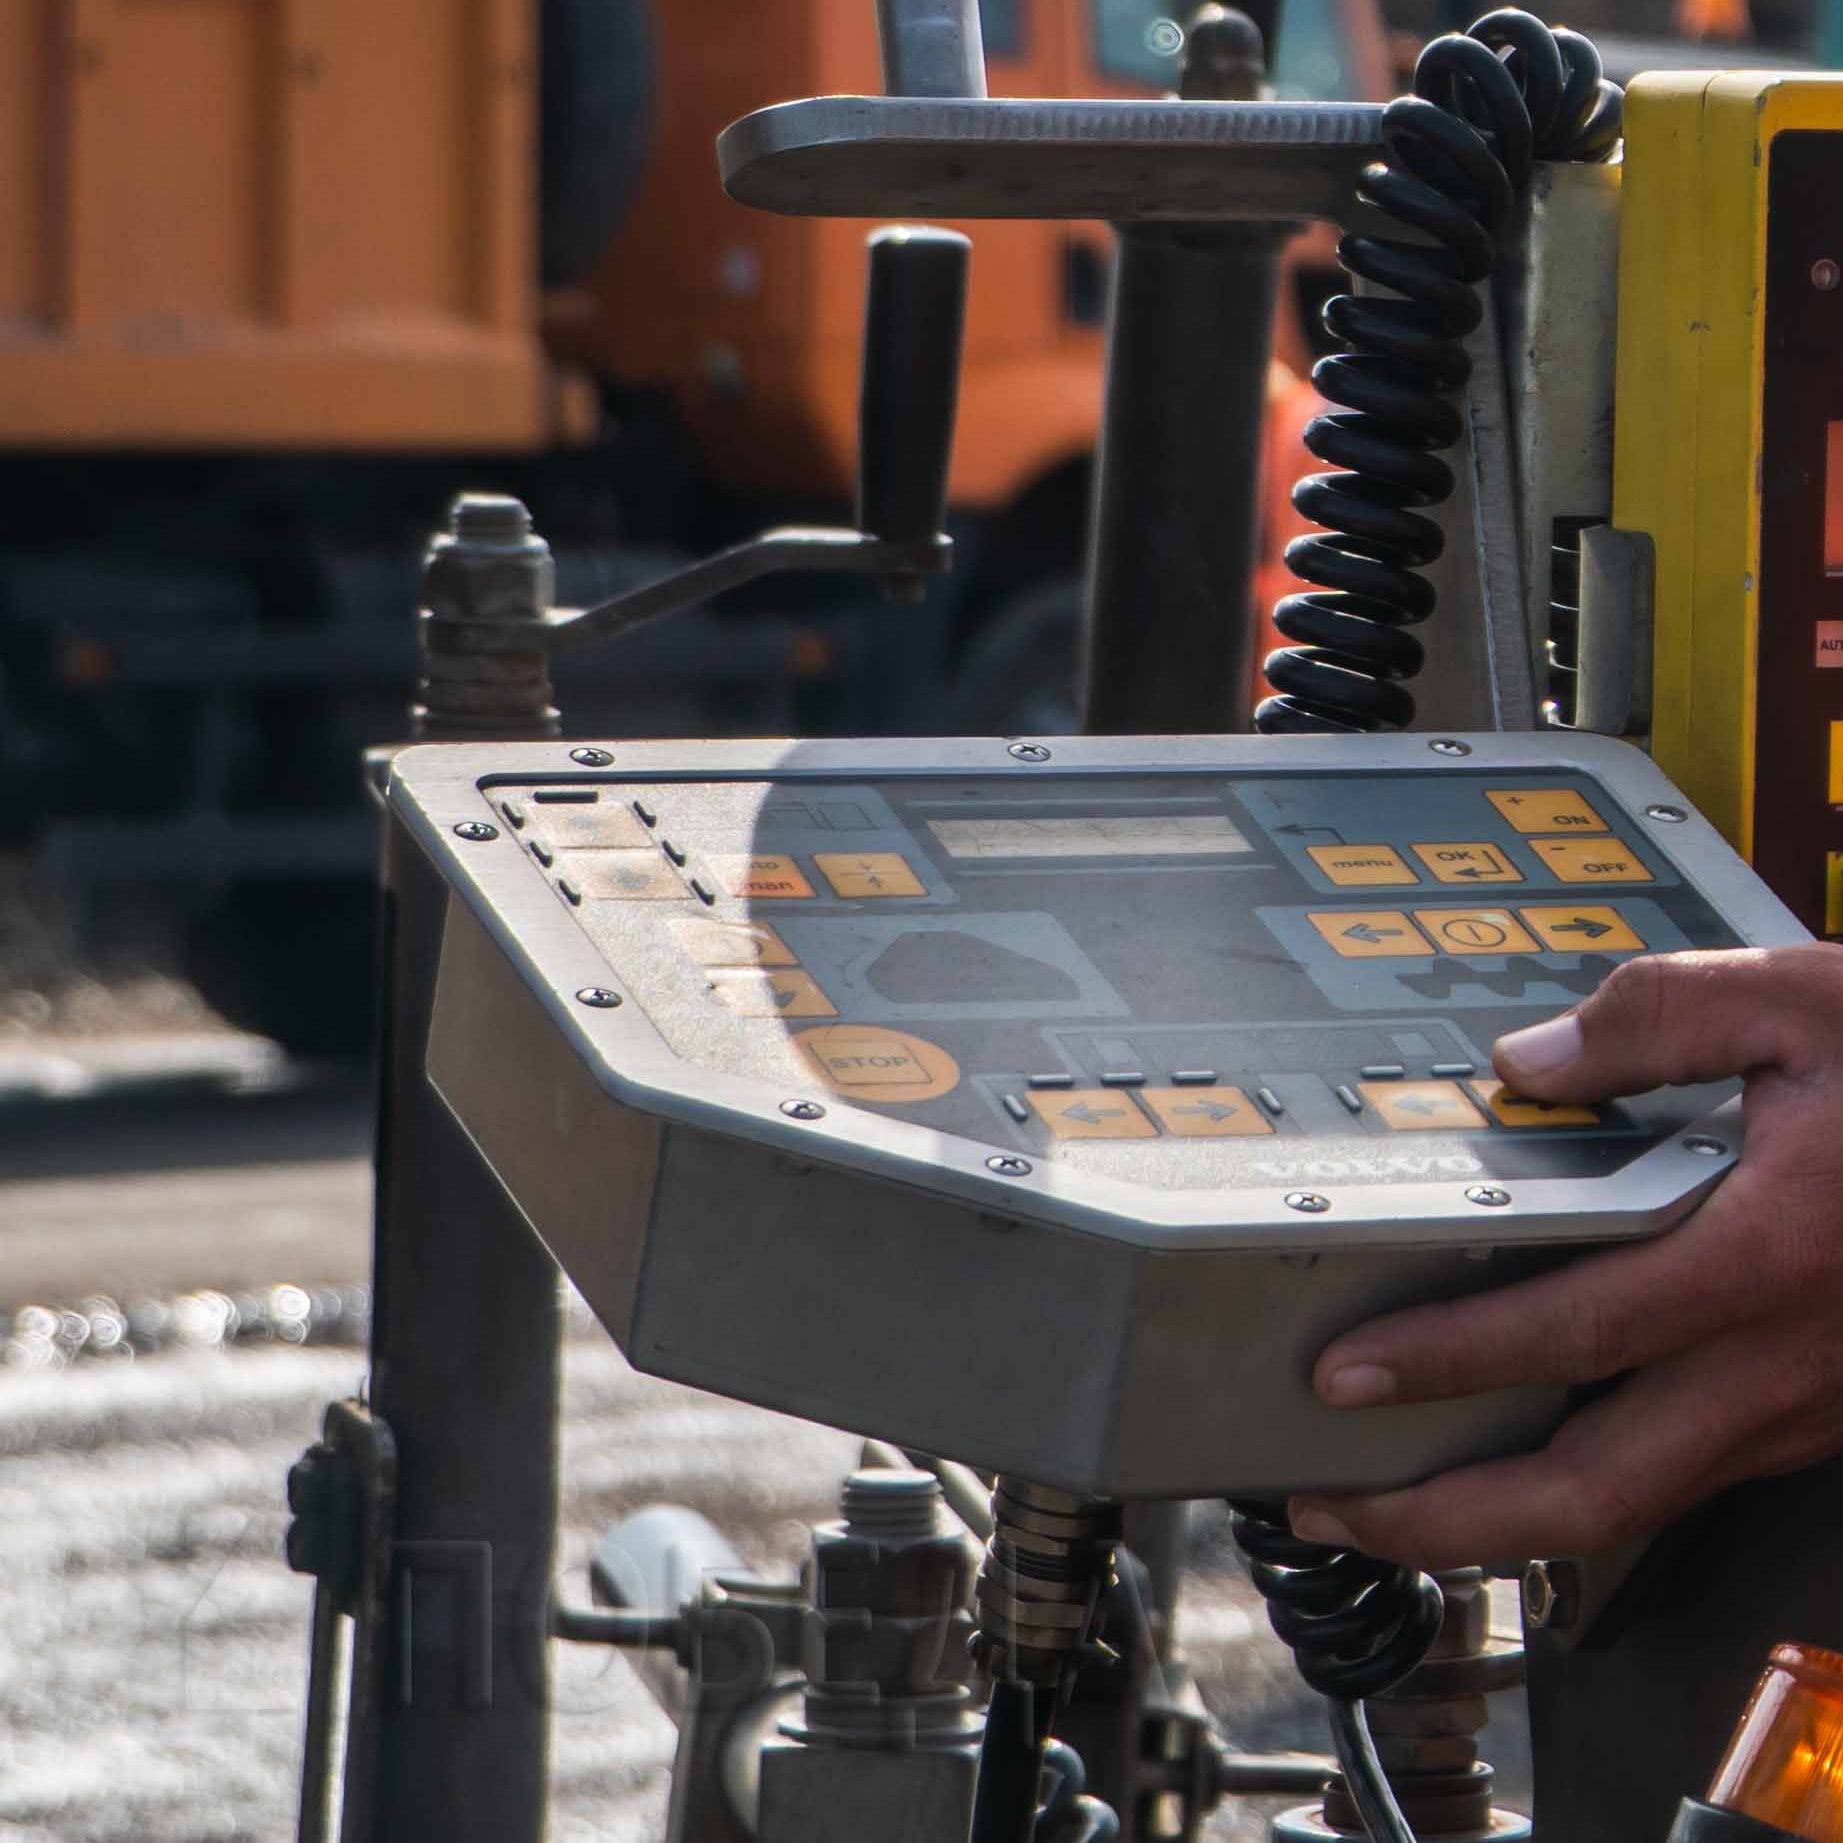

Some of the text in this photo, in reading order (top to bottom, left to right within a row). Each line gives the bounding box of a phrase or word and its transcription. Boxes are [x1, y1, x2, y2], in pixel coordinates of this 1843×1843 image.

[1552, 815, 1591, 825] ON
[1436, 850, 1476, 861] OK
[1331, 859, 1393, 868] menu
[1582, 862, 1628, 873] OFF
[829, 1056, 908, 1069] STOP
[1252, 1155, 1483, 1178] VOLVO
